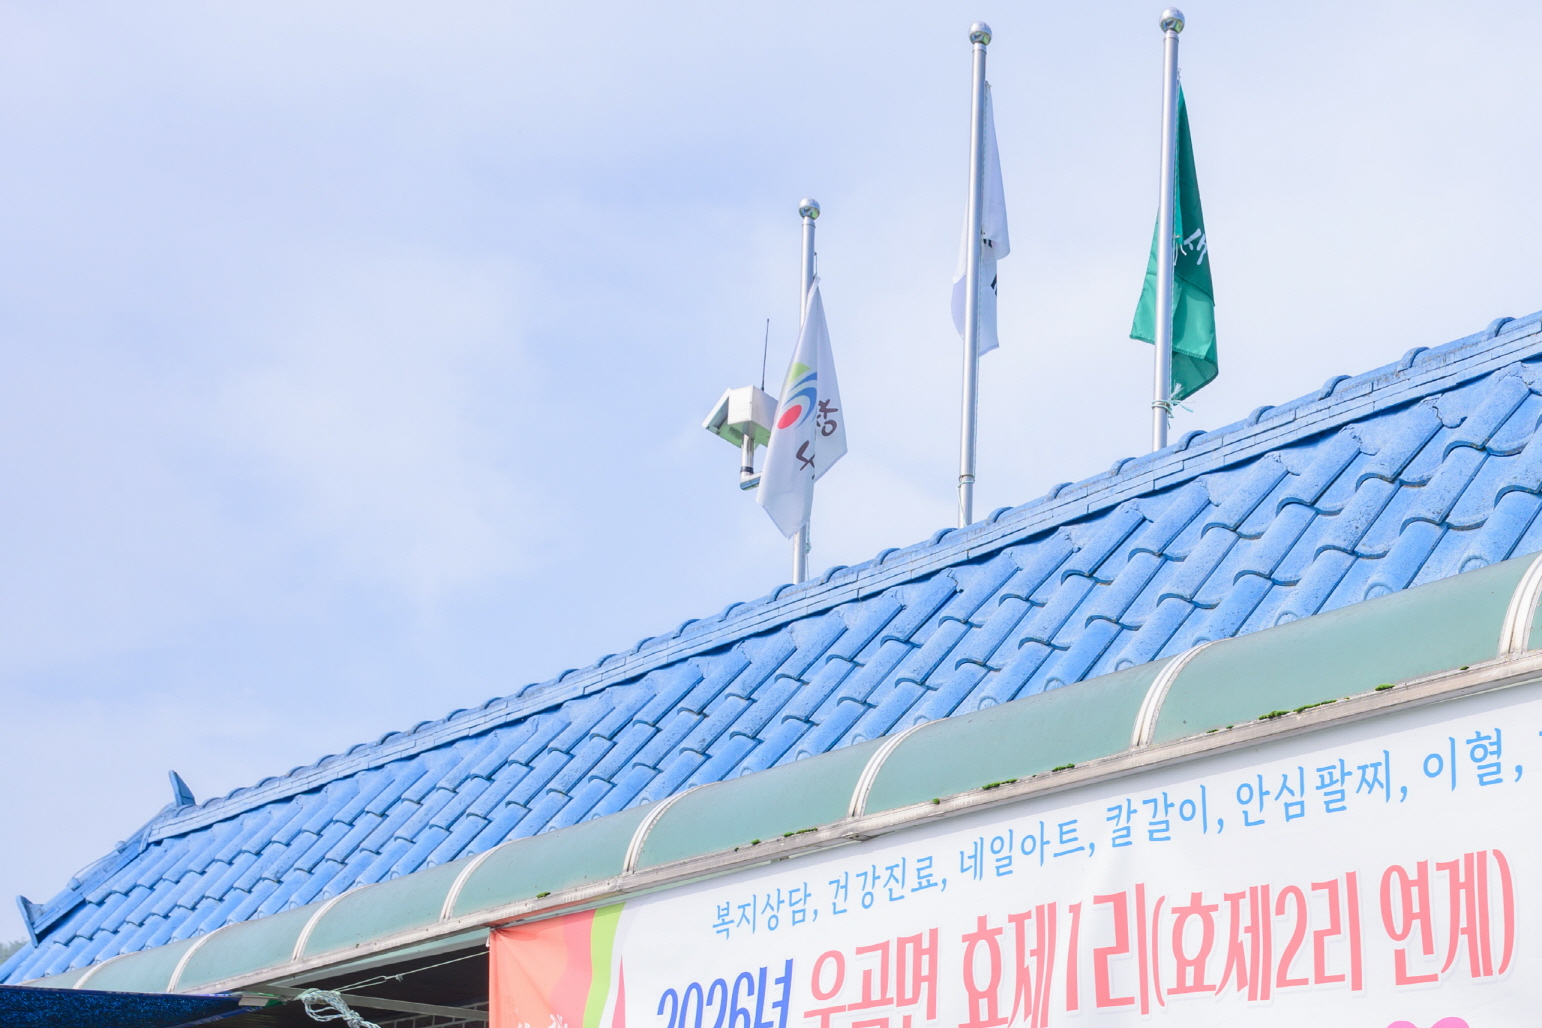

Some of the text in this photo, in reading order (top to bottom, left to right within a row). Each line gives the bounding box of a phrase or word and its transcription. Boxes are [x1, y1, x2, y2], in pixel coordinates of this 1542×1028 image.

[711, 884, 821, 941] 복지상담,
[827, 855, 948, 916] 건강진료,
[957, 817, 1096, 882] 네일아트,
[1103, 784, 1225, 848] 칼갈이,
[1235, 749, 1409, 828] 안심팔찌,
[1423, 727, 1524, 787] 이혈,
[1379, 848, 1517, 987] 연계)
